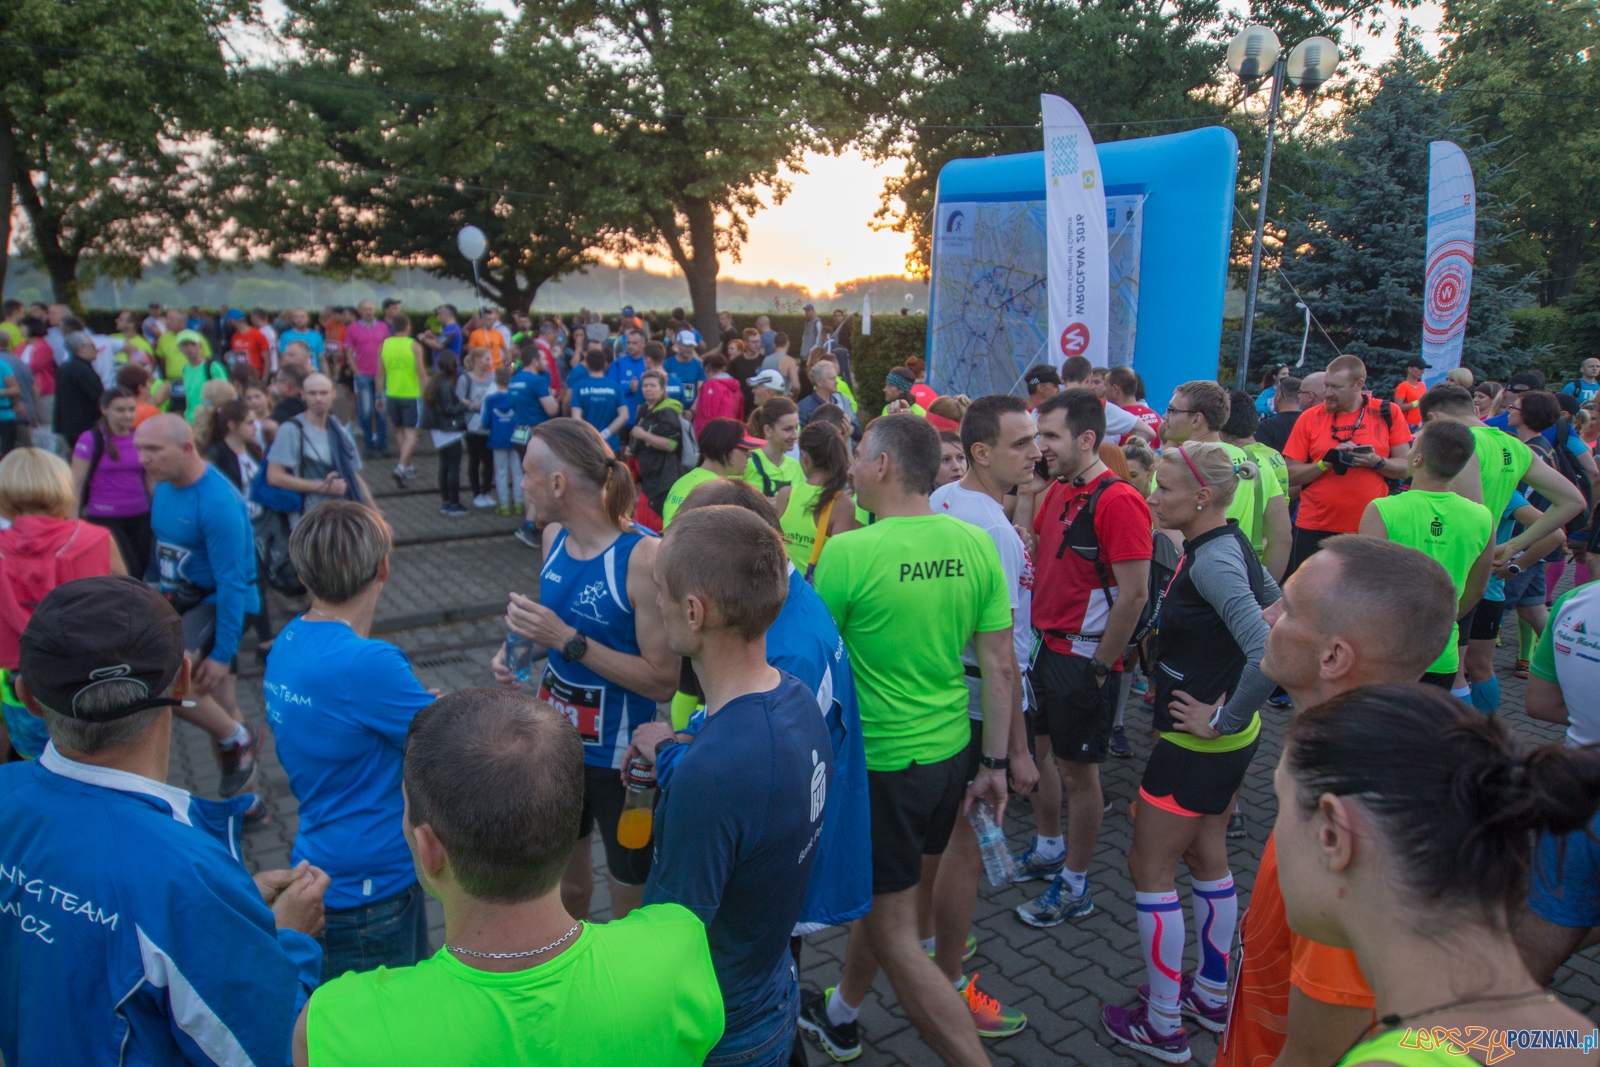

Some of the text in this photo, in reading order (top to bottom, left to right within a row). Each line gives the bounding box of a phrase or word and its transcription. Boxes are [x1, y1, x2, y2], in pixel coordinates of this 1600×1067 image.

[899, 558, 965, 582] PAWEŁ
[280, 684, 312, 708] TEAM
[48, 884, 119, 932] TEAM
